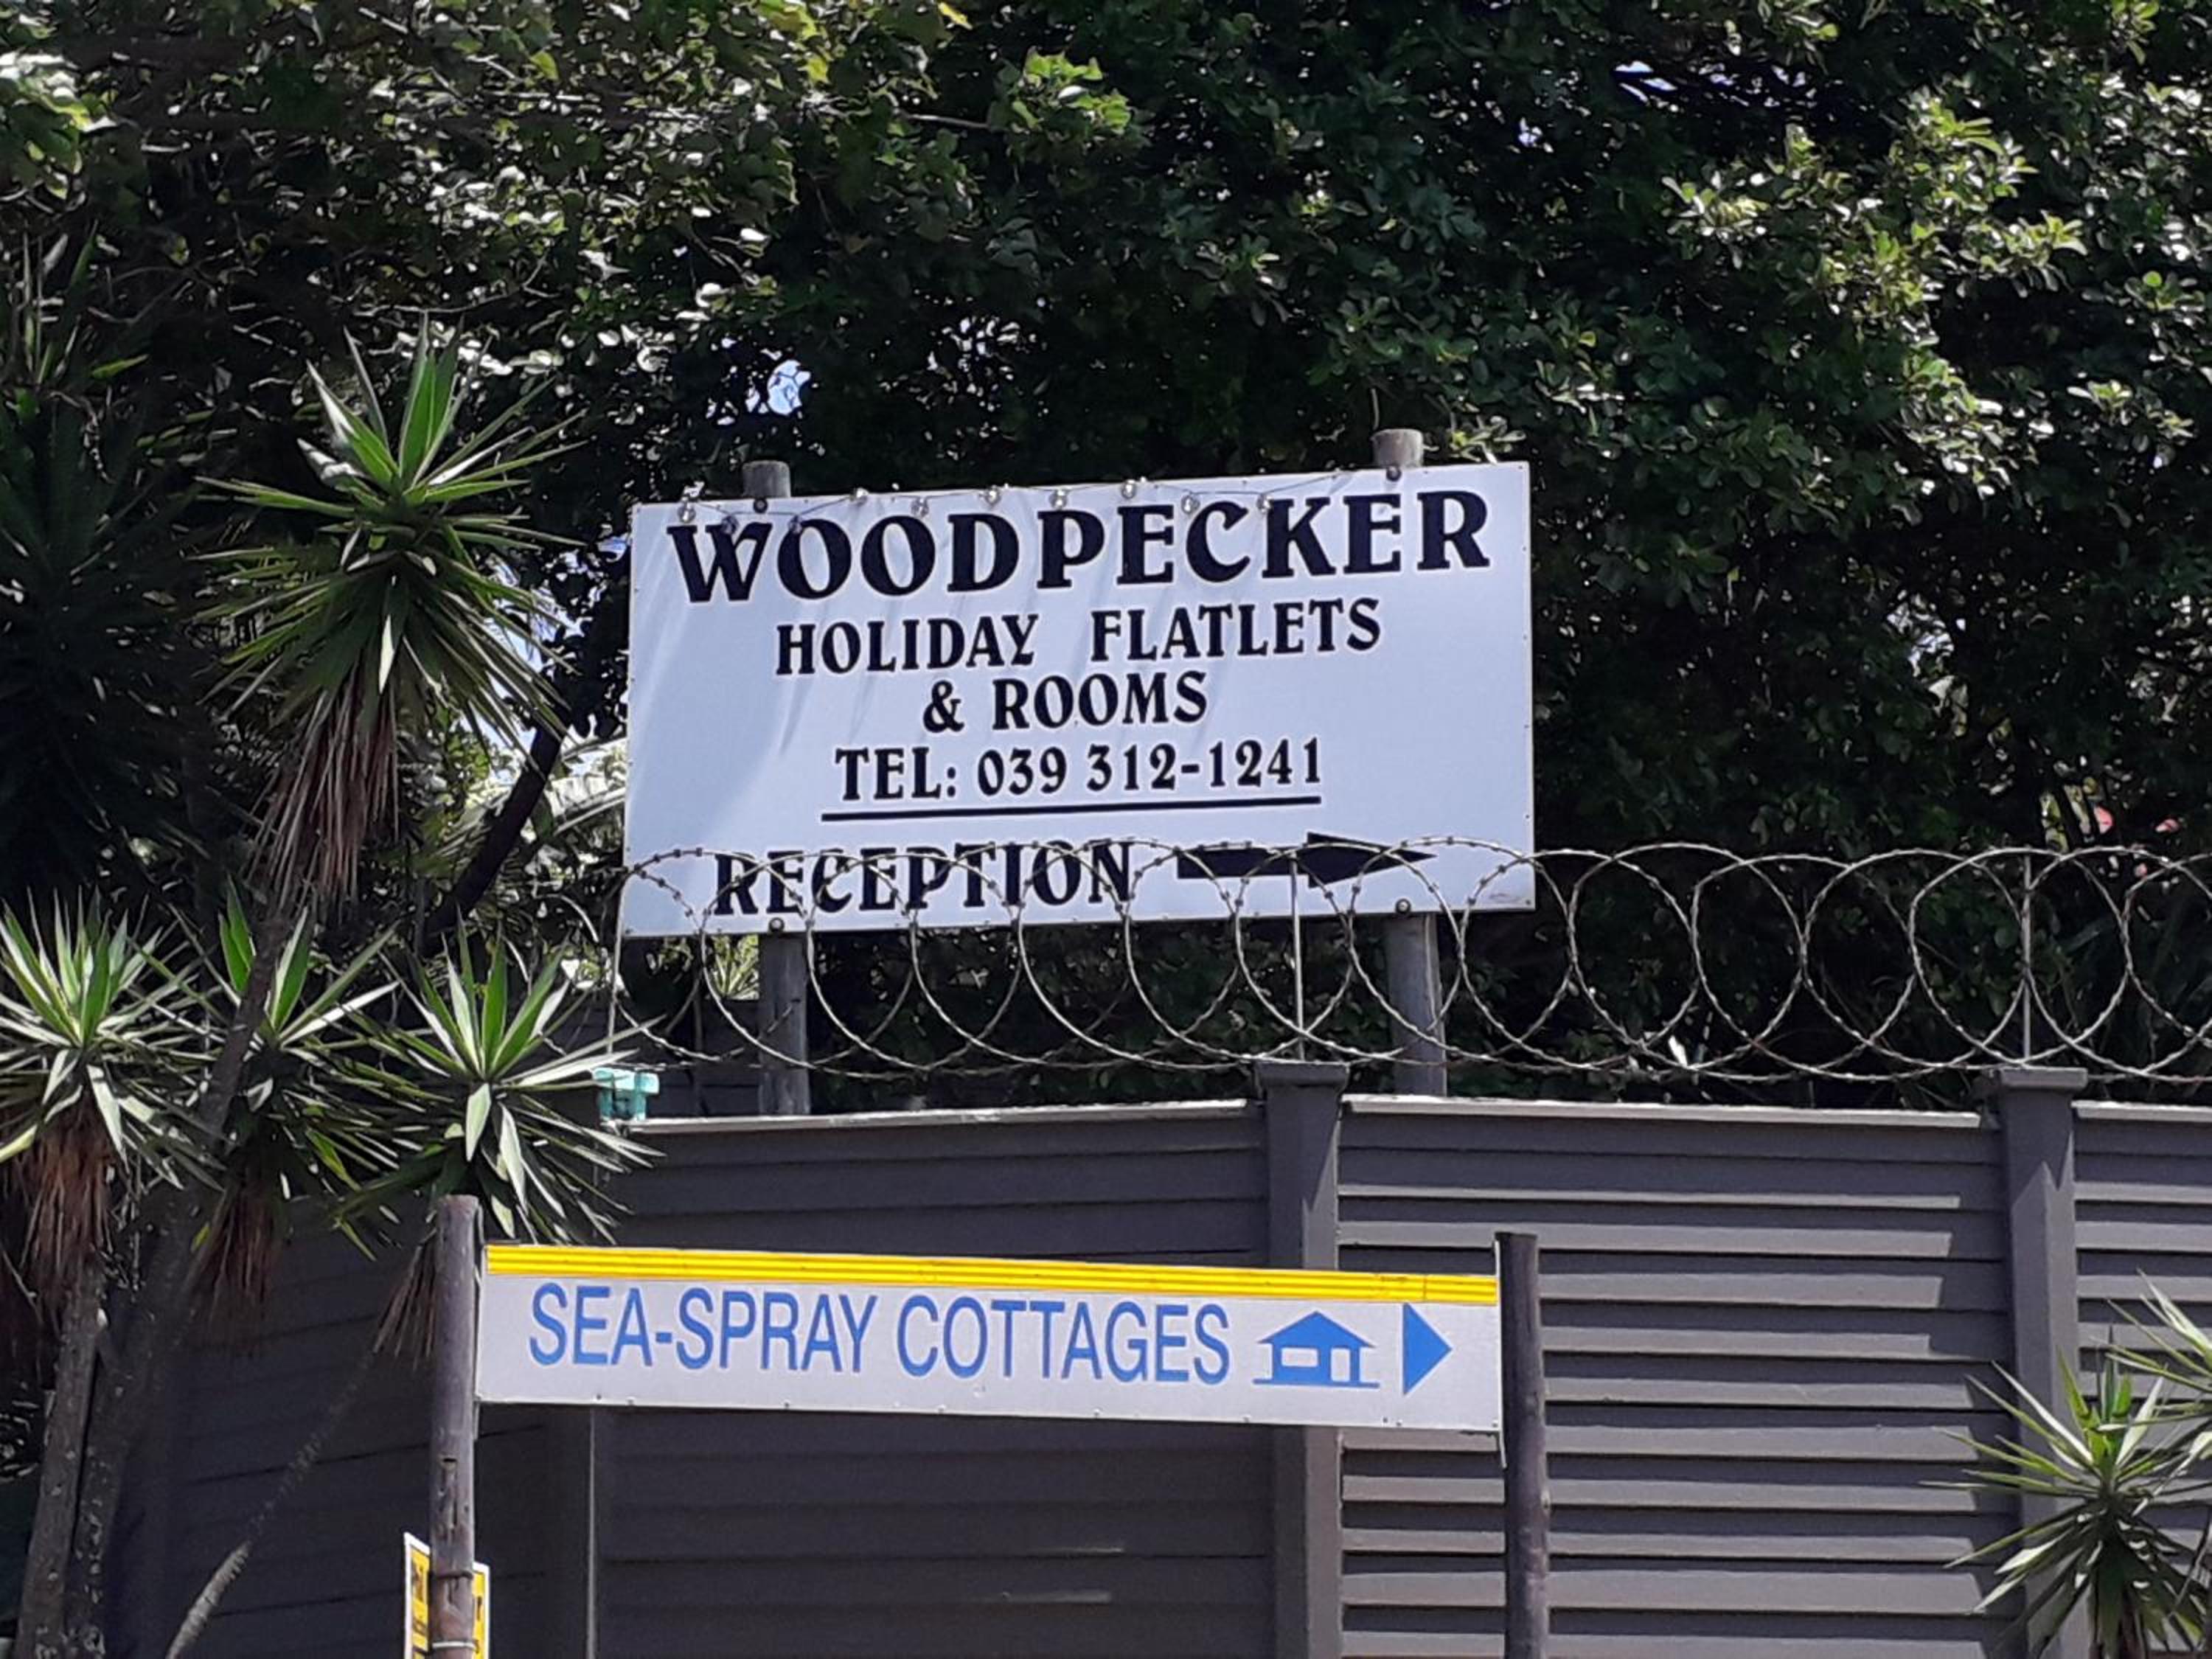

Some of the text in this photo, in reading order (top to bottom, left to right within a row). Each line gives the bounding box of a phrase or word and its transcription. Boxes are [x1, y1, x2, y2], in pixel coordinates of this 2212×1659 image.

[667, 490, 1489, 602] WOODPECKER
[776, 597, 1380, 675] HOLIDAY FLATLETS
[923, 670, 1207, 733] & ROOMS
[835, 737, 1321, 801] TEL: 039 312-1241
[714, 839, 1130, 915] RECEPTION
[529, 1281, 1230, 1385] SEA-SPRAY COTTAGES
